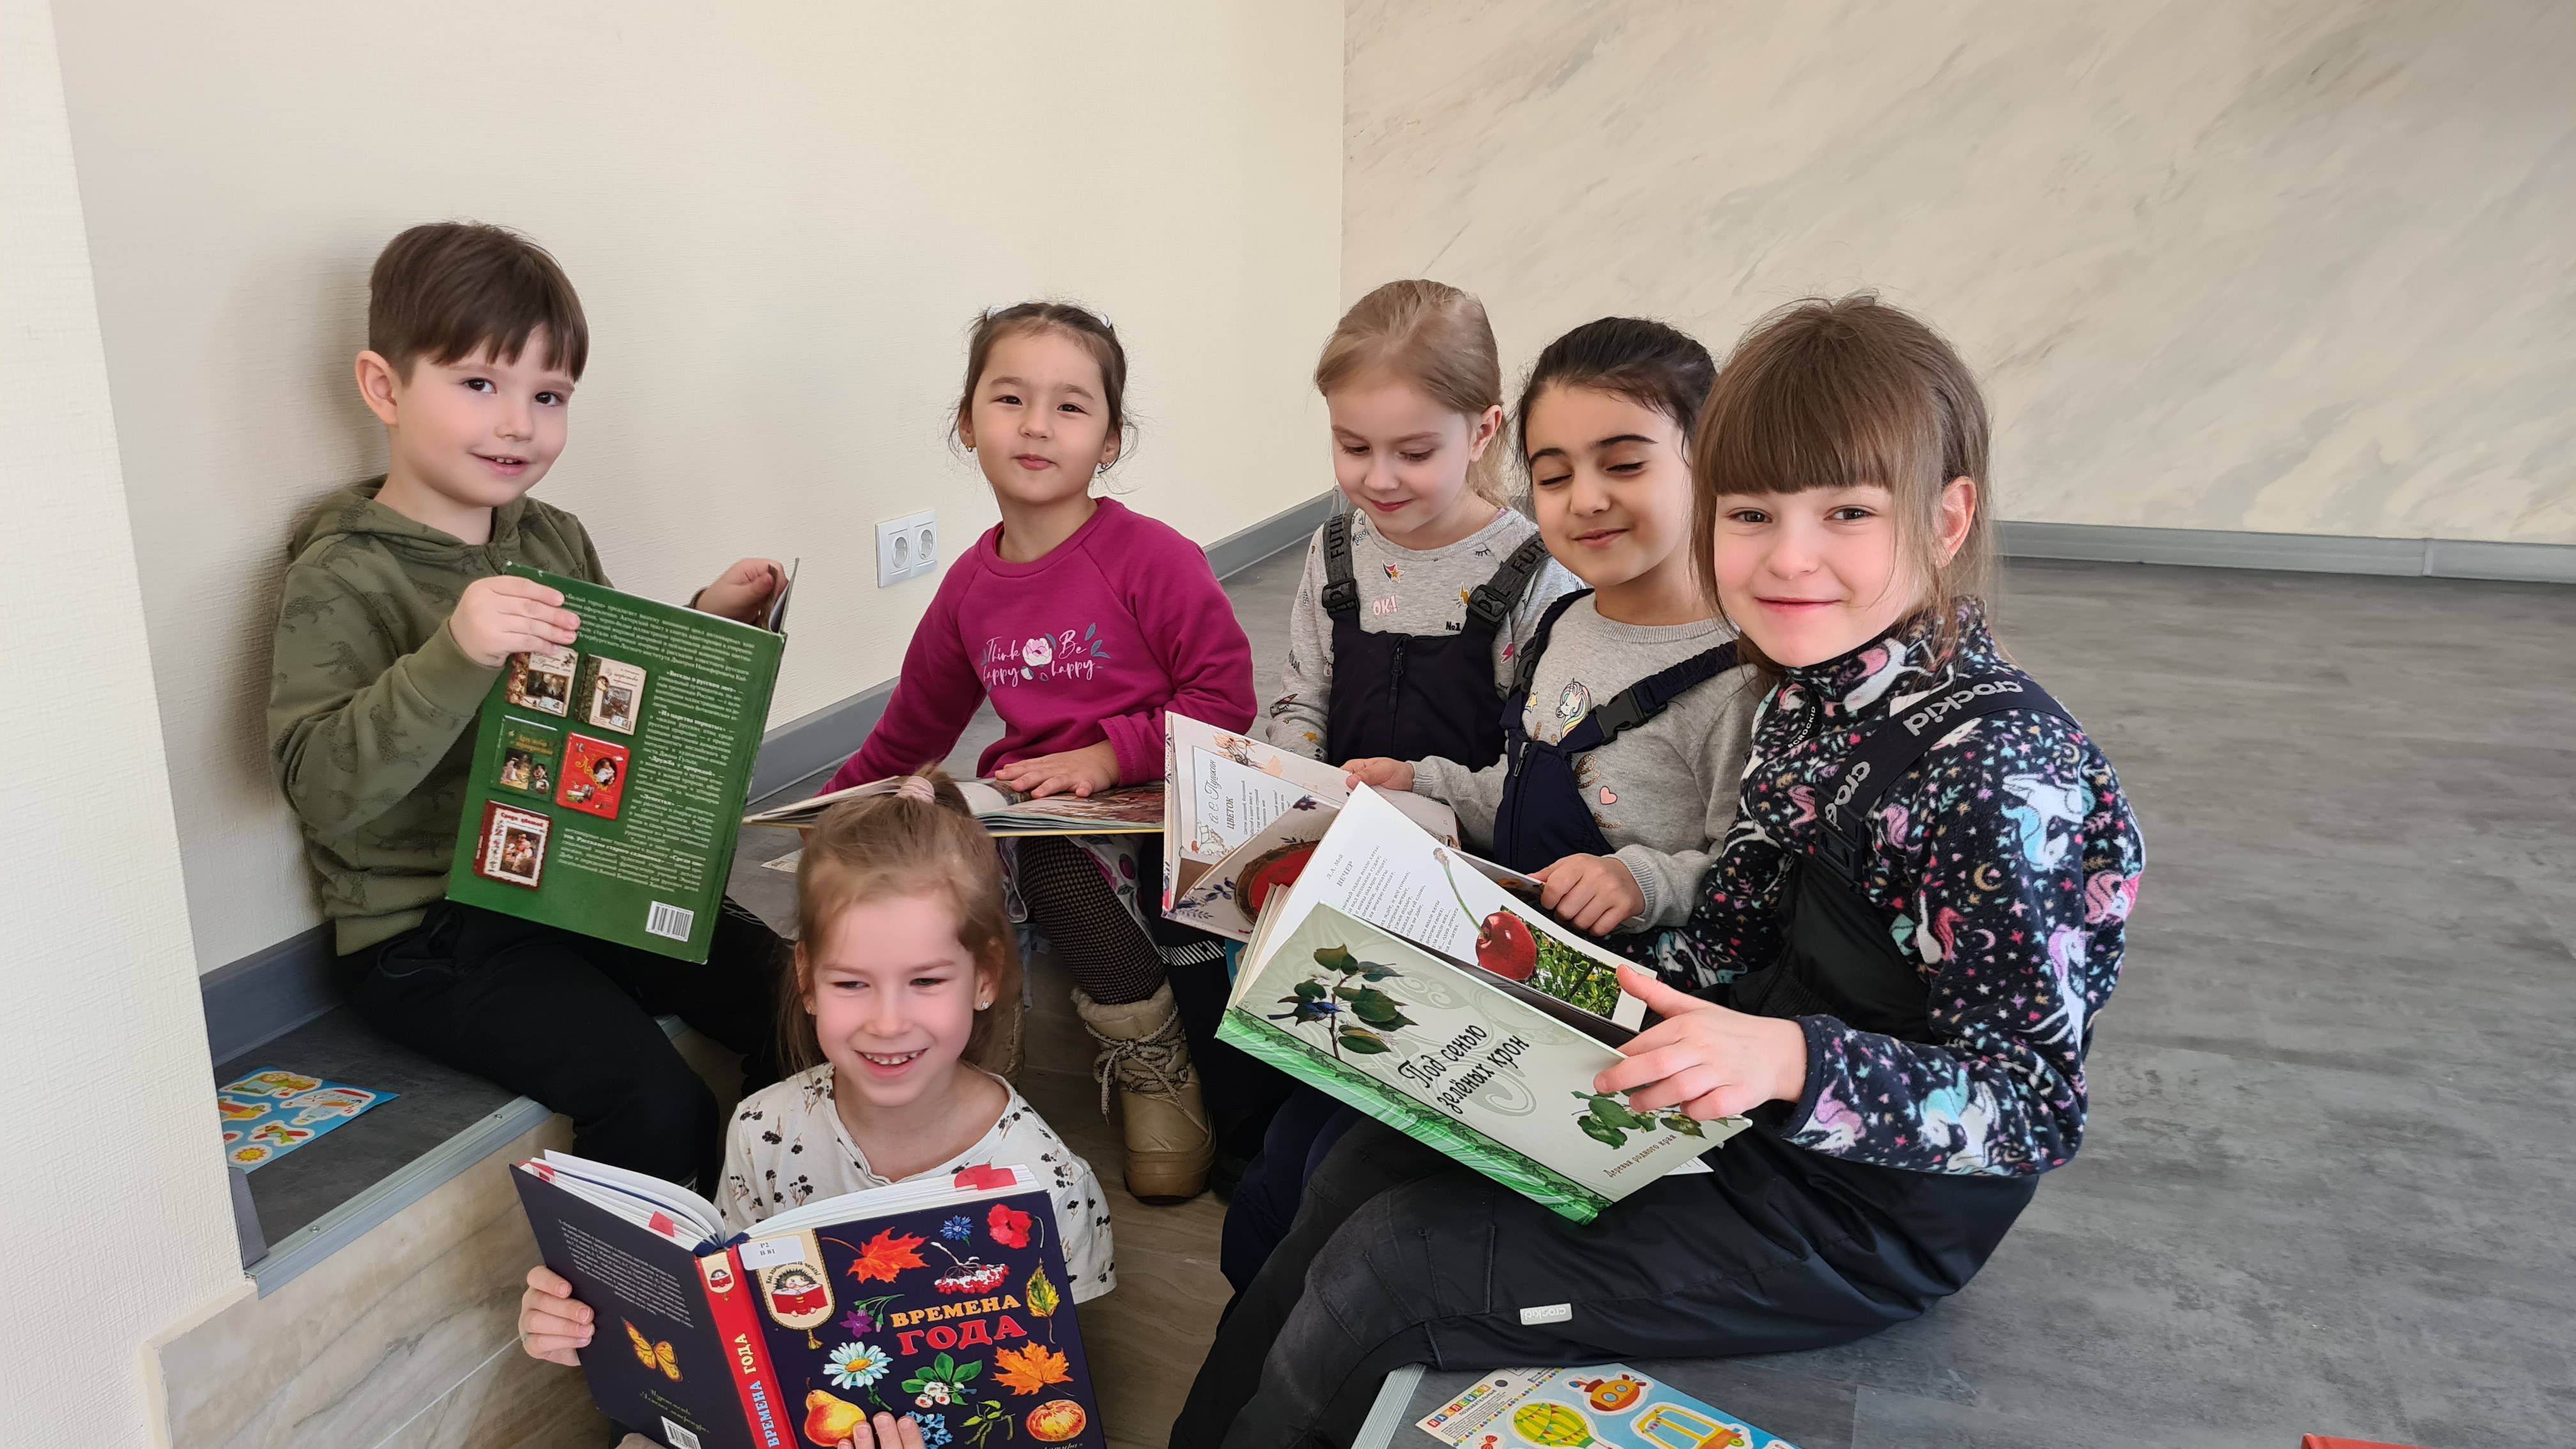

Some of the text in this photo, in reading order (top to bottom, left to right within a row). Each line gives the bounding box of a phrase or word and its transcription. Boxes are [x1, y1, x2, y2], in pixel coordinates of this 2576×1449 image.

[1373, 595, 1398, 616] OK!
[986, 636, 1020, 663] Think
[1059, 629, 1087, 659] Be
[983, 666, 1020, 688] happy
[1051, 659, 1095, 680] happy
[1903, 680, 2024, 736] crockid
[1204, 760, 1222, 800] Пушкин
[1226, 797, 1234, 829] ЦВЕТОК
[1337, 861, 1353, 887] ВЕЧЕР
[1397, 1025, 1487, 1088] Под сенью
[1437, 1035, 1530, 1114] зелёных крон
[1603, 1134, 1676, 1178] Деревья родного края
[890, 1294, 1022, 1328] ВРЕМЕНА
[1524, 1307, 1567, 1320] crockid
[896, 1315, 1028, 1356] ГОДА
[734, 1333, 780, 1448] ВРЕМЕНА ГОДА
[1427, 1384, 1491, 1428] НАКЛЕЙКИ
